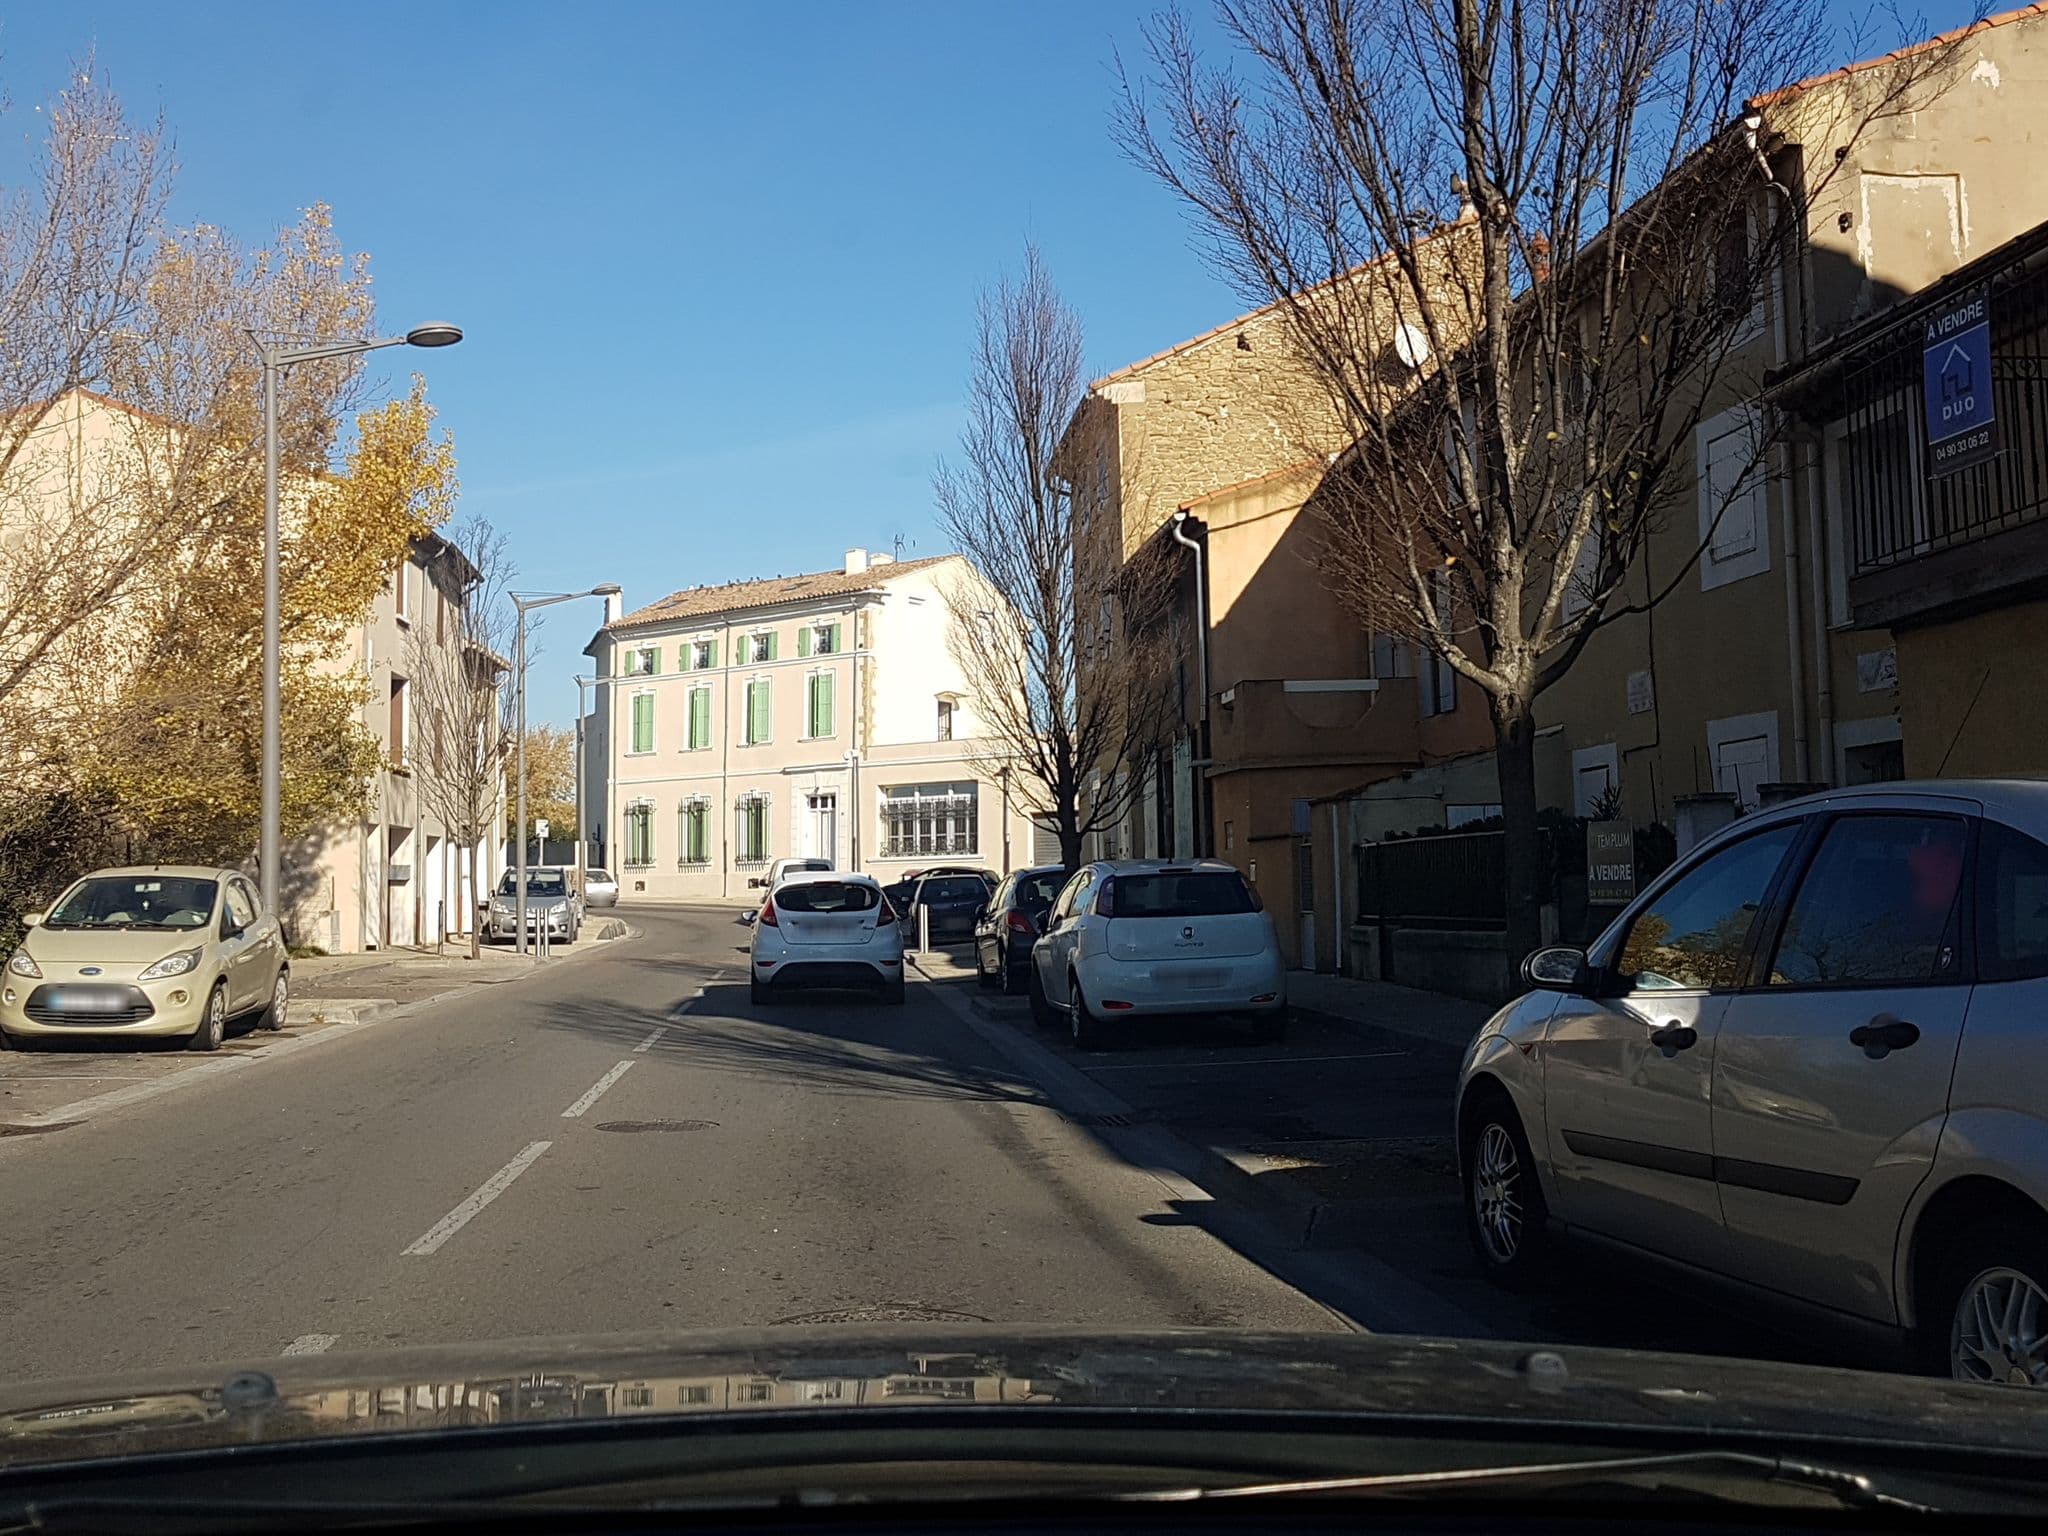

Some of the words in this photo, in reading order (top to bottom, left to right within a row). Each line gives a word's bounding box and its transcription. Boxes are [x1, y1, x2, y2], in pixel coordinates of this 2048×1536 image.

[1927, 324, 1936, 341] A
[1937, 299, 1984, 334] VENDRE
[1942, 396, 1975, 421] DUO
[1936, 447, 1946, 461] 04
[1946, 443, 1956, 457] 90
[1978, 431, 1989, 445] 22
[1589, 864, 1595, 881] A
[1596, 863, 1632, 881] VENDRE
